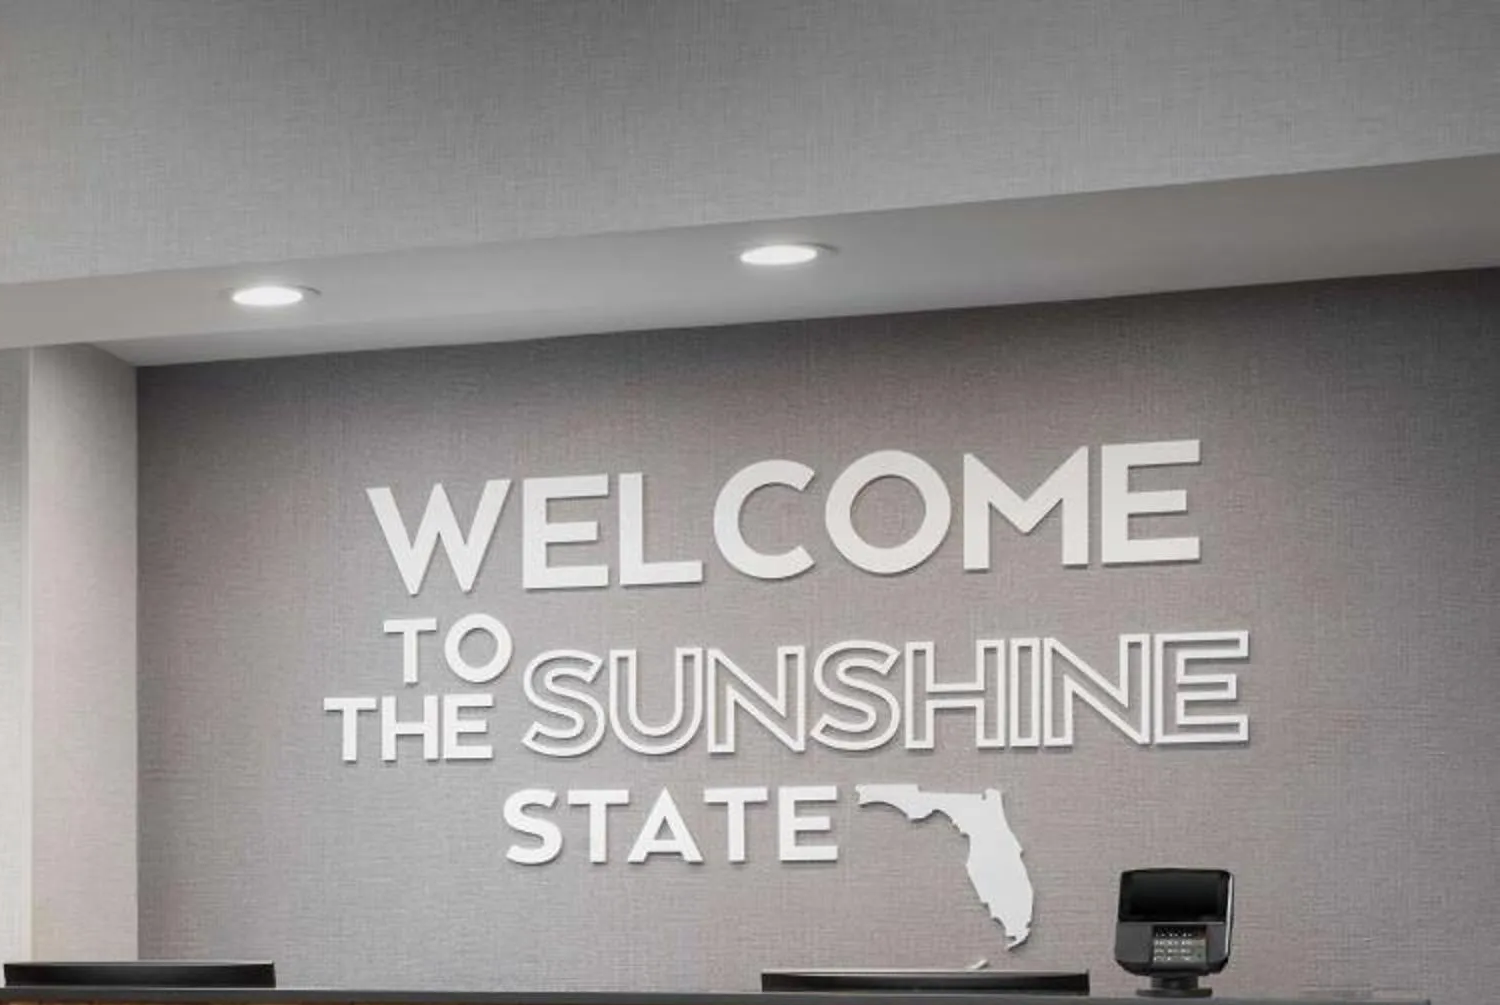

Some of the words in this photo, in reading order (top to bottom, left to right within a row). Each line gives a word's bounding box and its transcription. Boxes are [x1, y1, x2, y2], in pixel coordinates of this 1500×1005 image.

[365, 438, 1201, 596] WELCOME
[323, 692, 496, 763] THE
[520, 628, 1250, 757] SUNSHINE
[383, 613, 513, 685] TO
[502, 784, 839, 865] STATE
